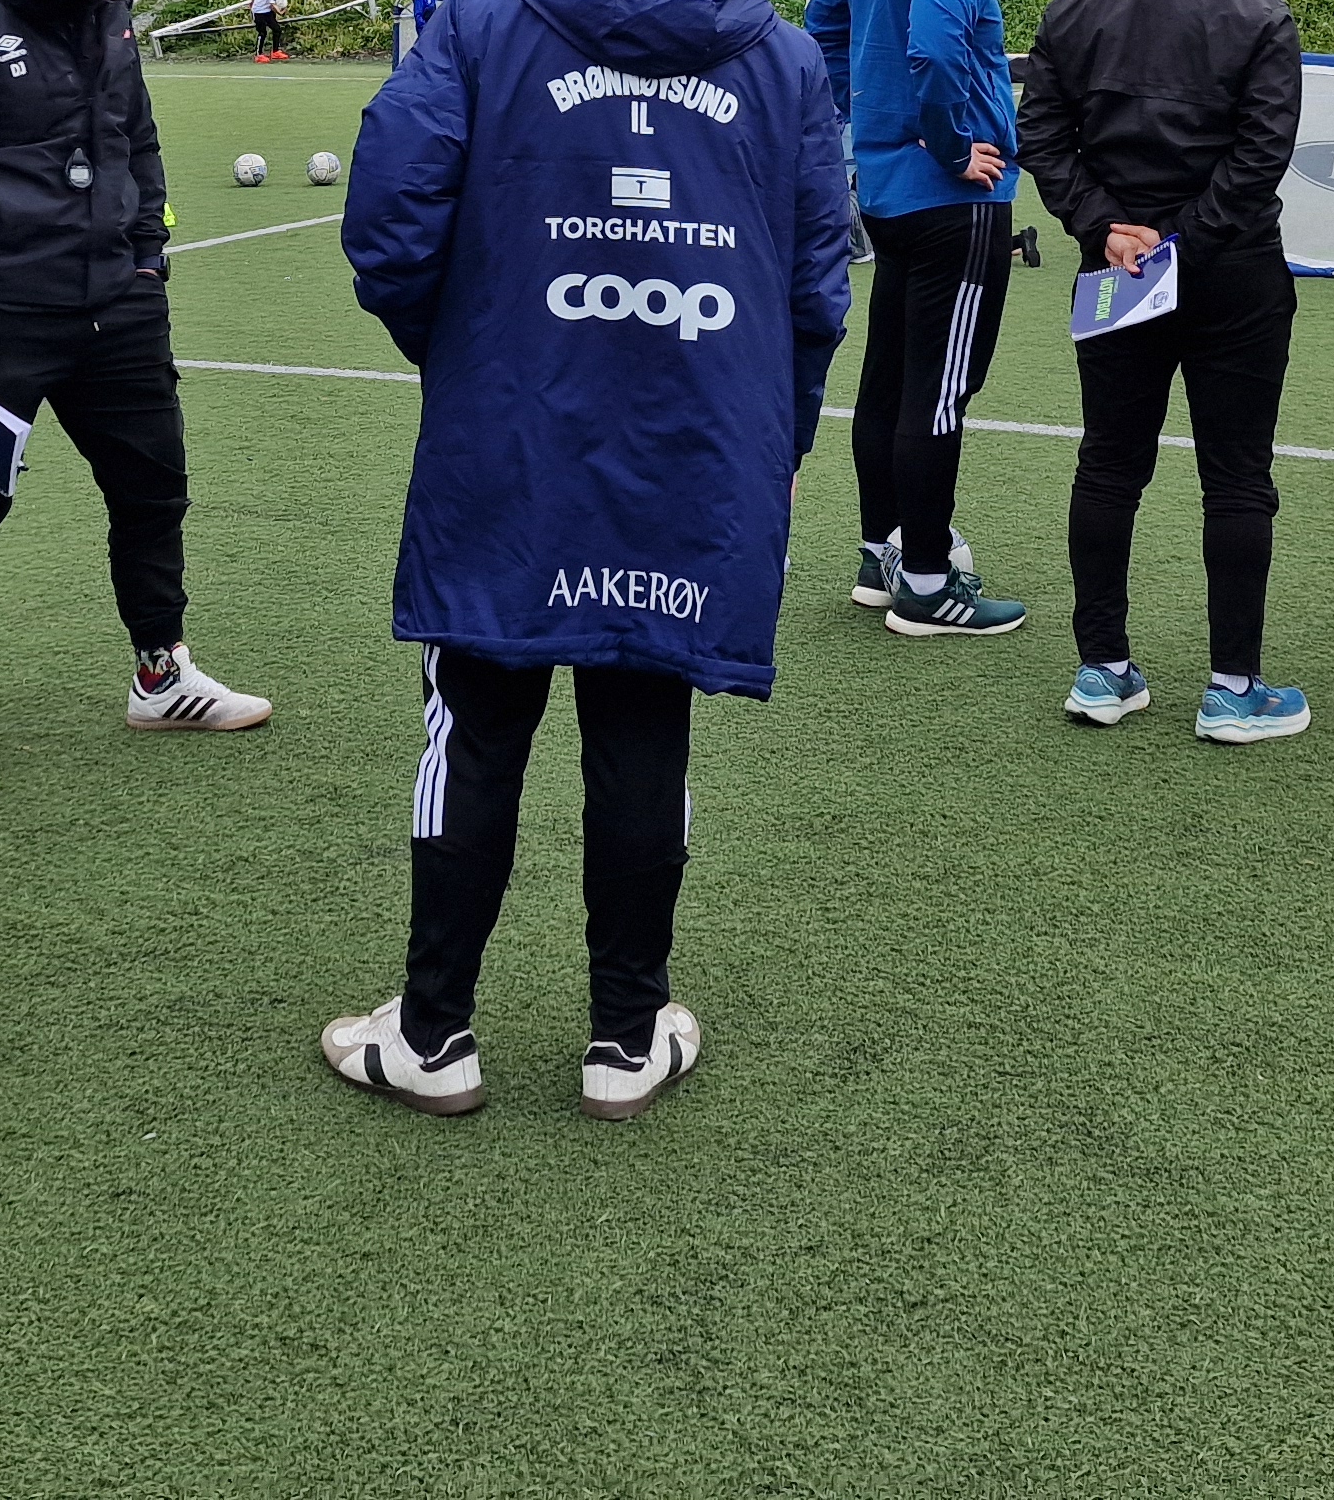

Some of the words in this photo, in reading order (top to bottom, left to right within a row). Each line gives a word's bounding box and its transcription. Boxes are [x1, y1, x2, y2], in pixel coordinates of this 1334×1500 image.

[547, 65, 739, 124] BRØNNØYSUND
[631, 101, 655, 135] IL
[545, 217, 736, 249] TORGHATTEN
[546, 273, 736, 341] coop
[547, 567, 710, 624] AAKERØY
